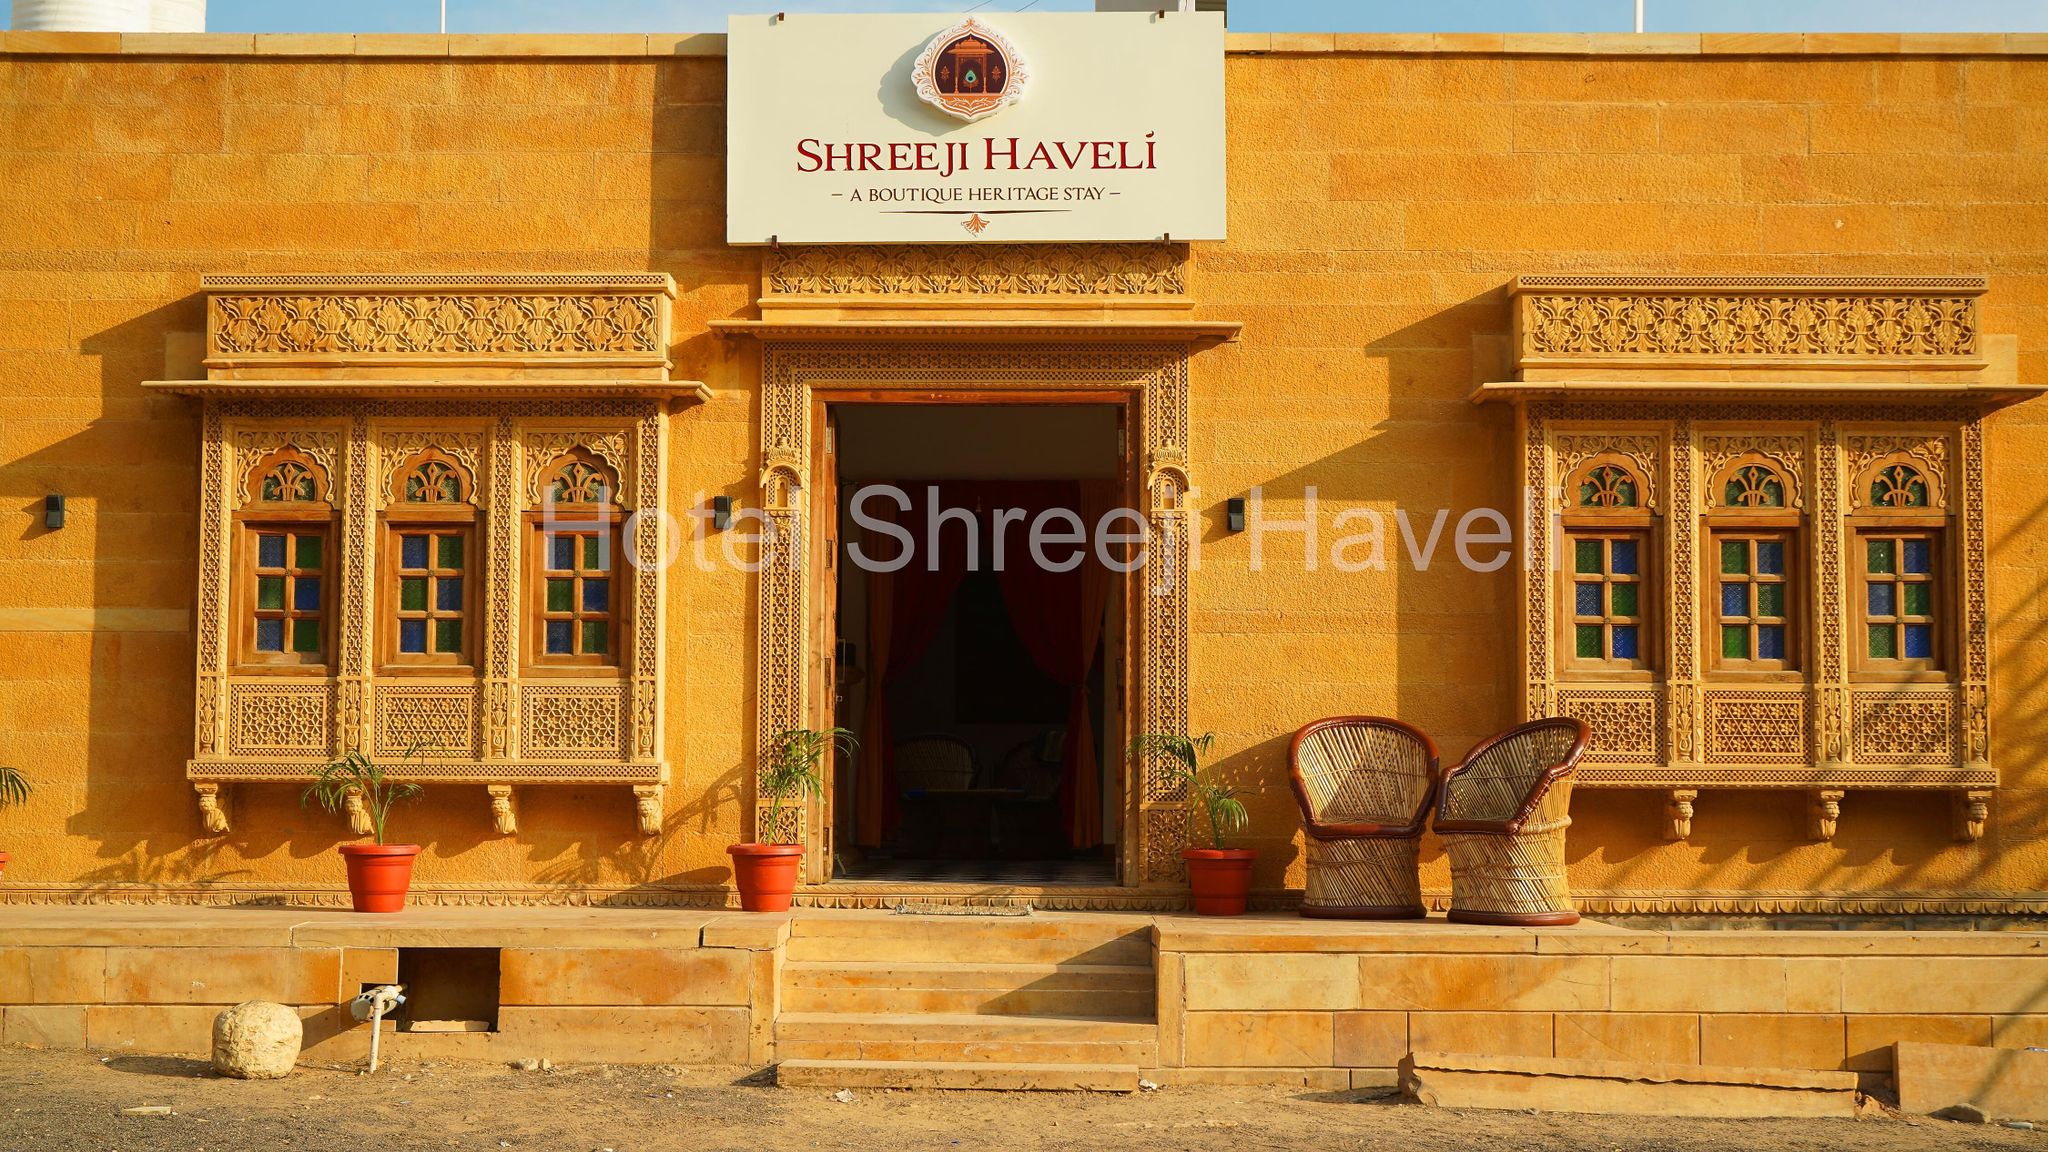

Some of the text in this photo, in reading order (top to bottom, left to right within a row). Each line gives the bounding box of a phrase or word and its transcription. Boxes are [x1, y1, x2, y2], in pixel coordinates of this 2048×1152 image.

[797, 138, 968, 177] SHREEJI
[850, 186, 1105, 203] A BOUTIQUE HERITAGE STAY
